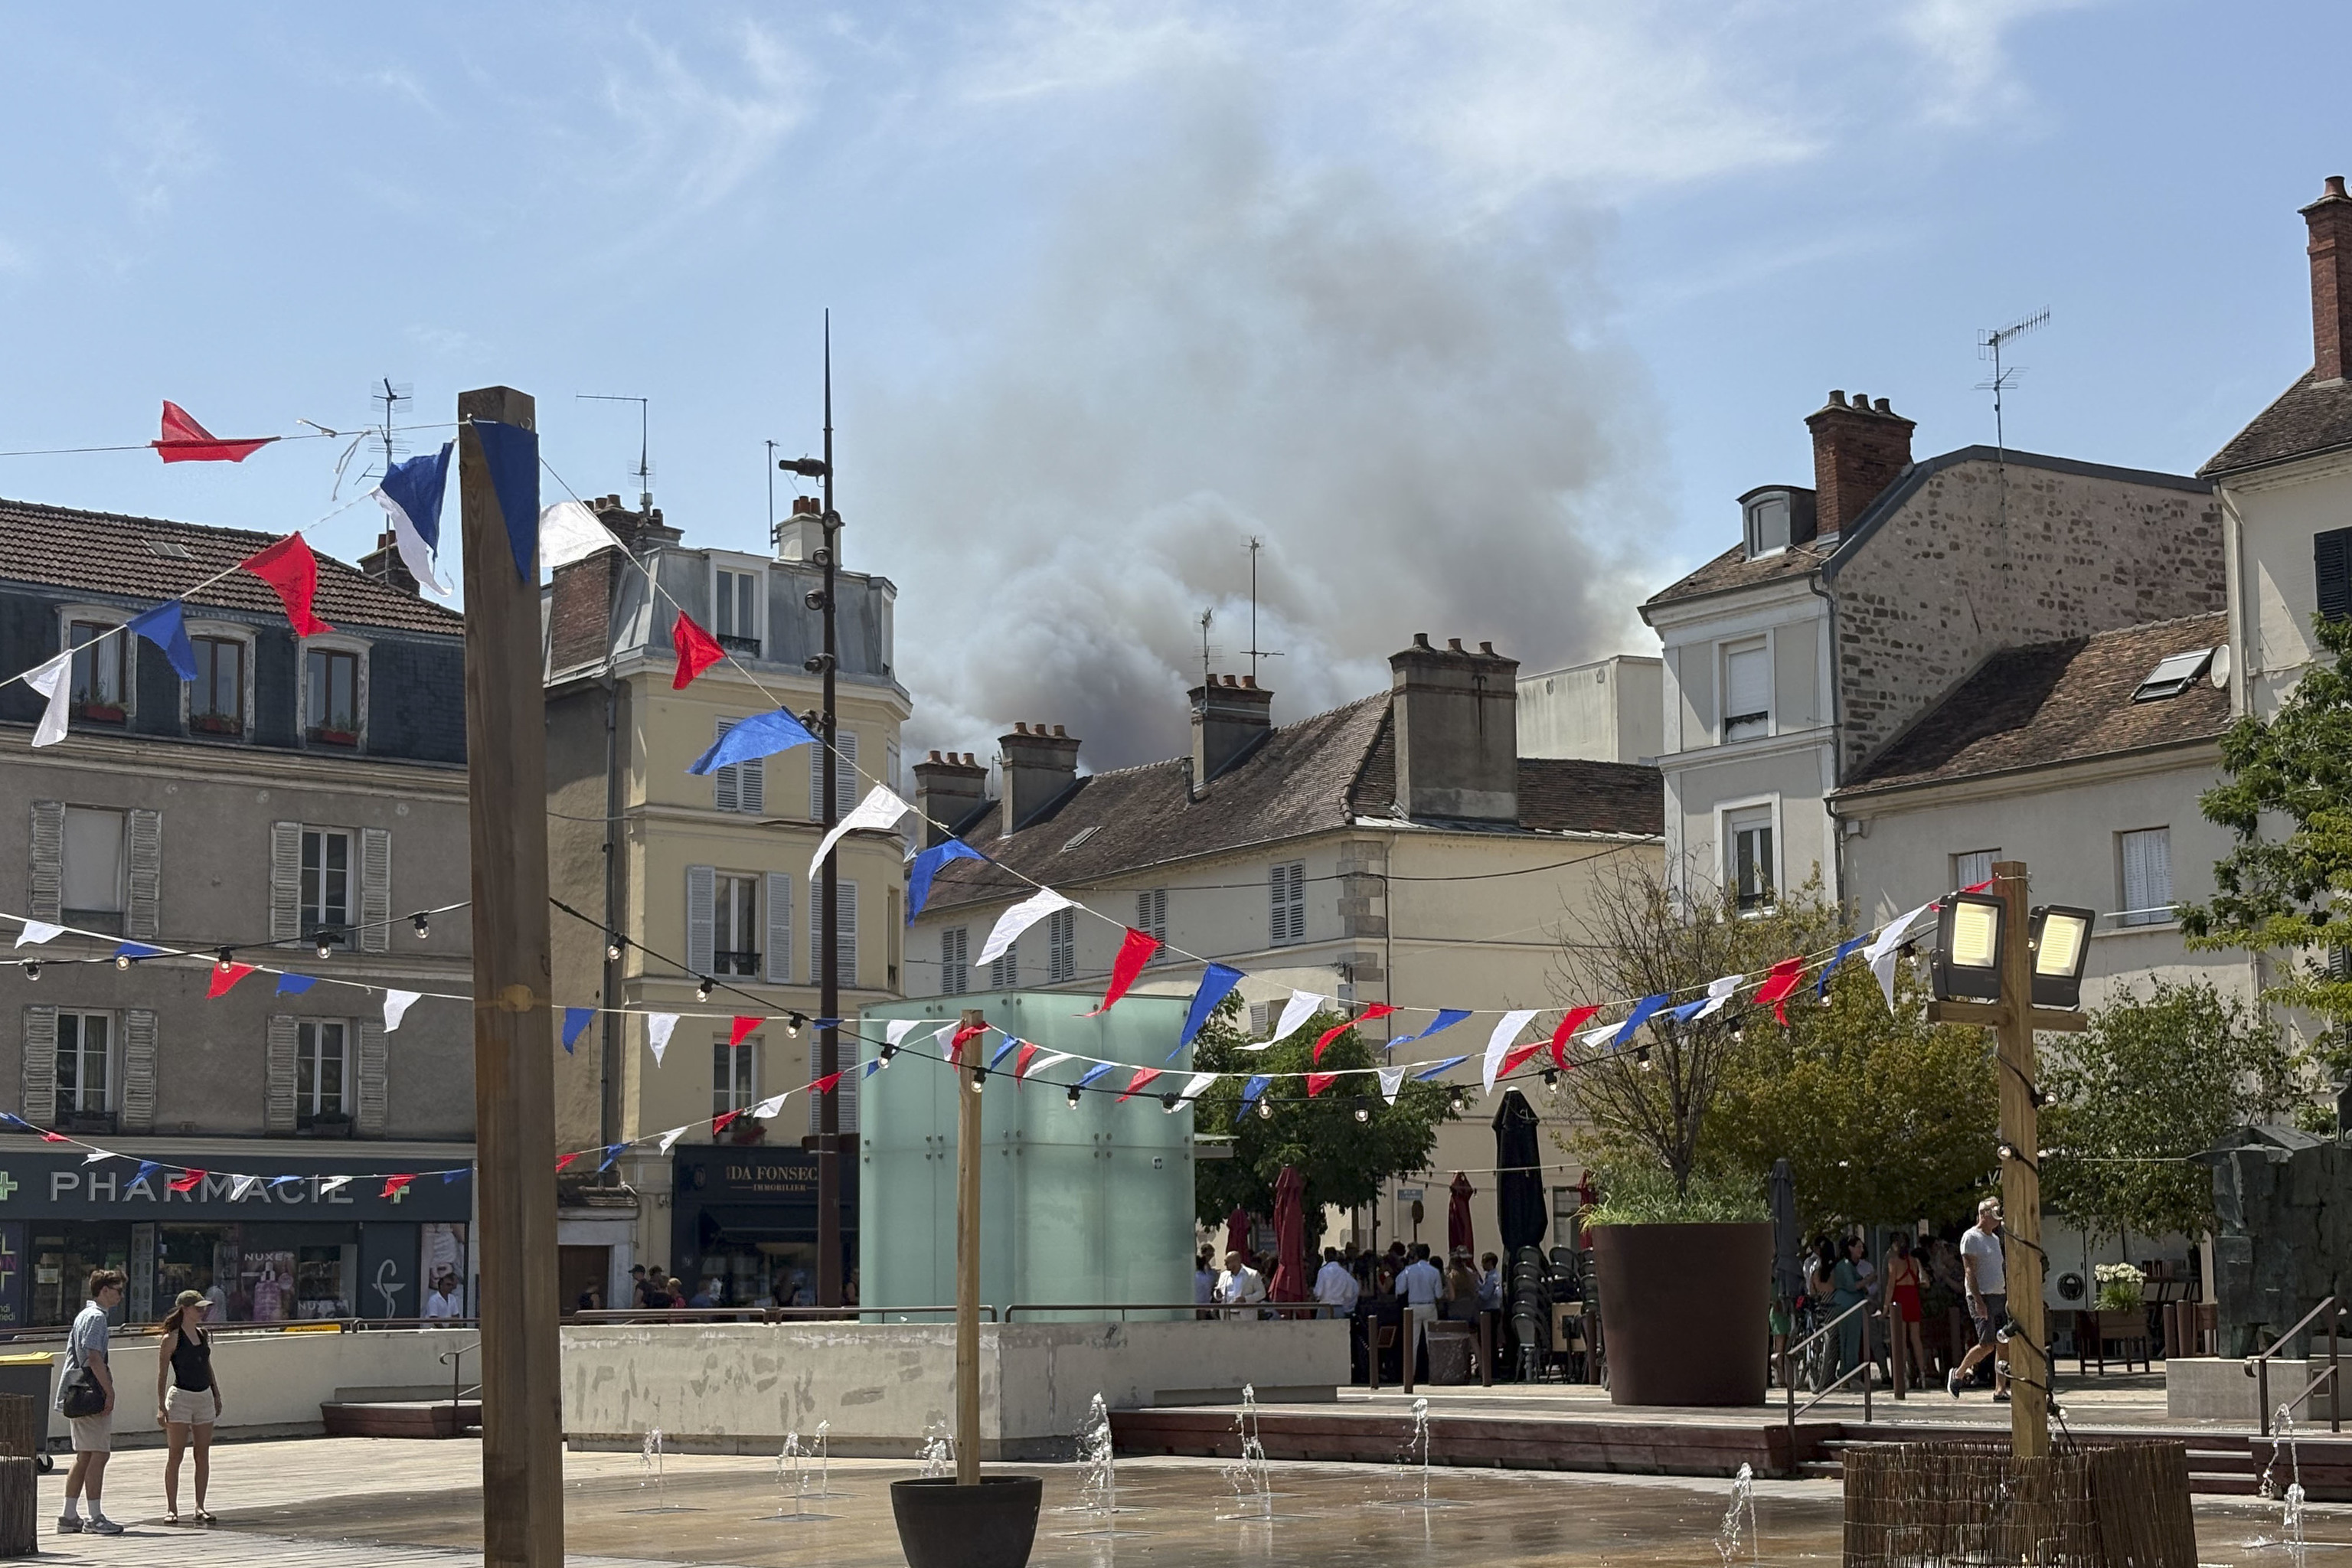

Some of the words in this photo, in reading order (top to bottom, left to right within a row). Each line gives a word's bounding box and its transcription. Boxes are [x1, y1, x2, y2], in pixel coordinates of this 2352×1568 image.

[731, 1166, 752, 1180] DA
[756, 1166, 818, 1180] FONSEC
[50, 1171, 354, 1204] PHARMACIE
[244, 1253, 284, 1261] NUXE
[297, 1302, 335, 1310] NUXE
